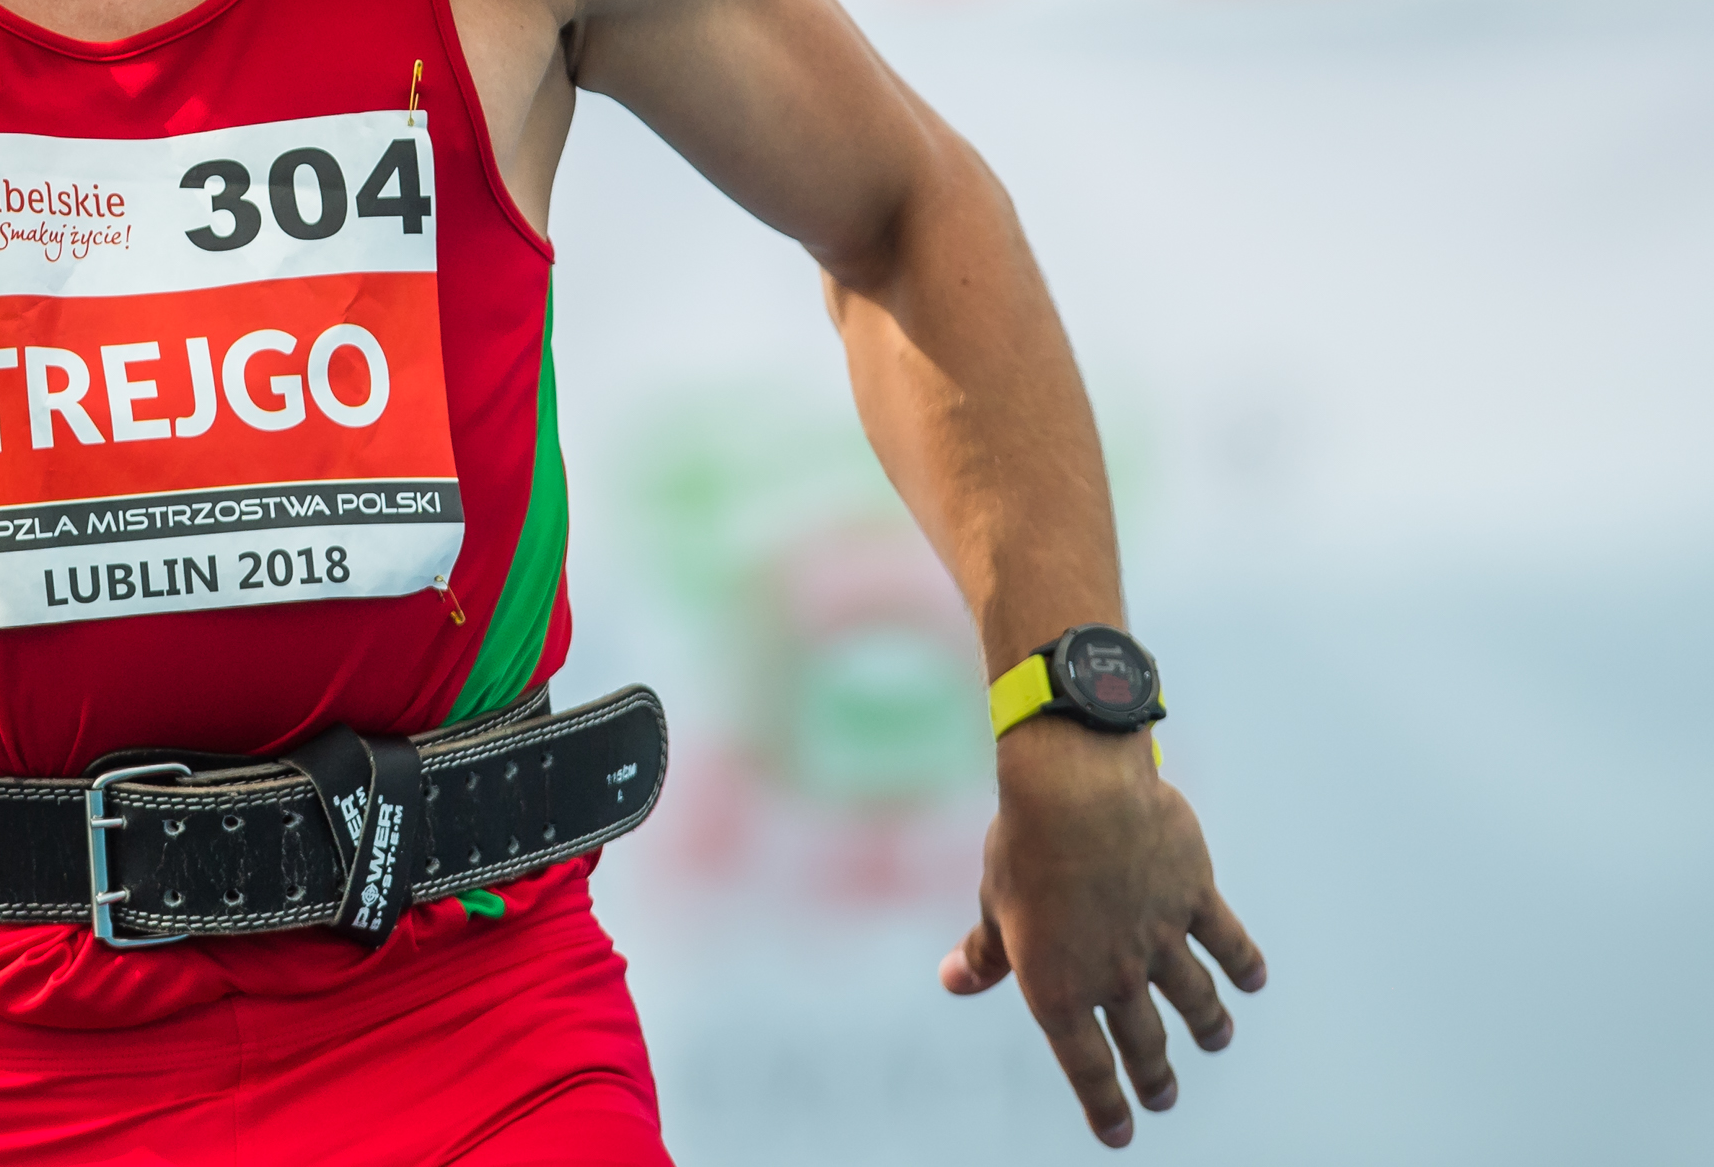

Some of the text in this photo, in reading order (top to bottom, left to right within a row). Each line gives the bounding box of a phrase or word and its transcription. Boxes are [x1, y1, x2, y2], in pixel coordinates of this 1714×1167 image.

[179, 138, 432, 252] 304
[70, 224, 132, 260] życie!
[86, 494, 331, 534] MISTRZOSTWA
[337, 491, 442, 515] POLSKI
[43, 545, 352, 607] LUBLIN 2018
